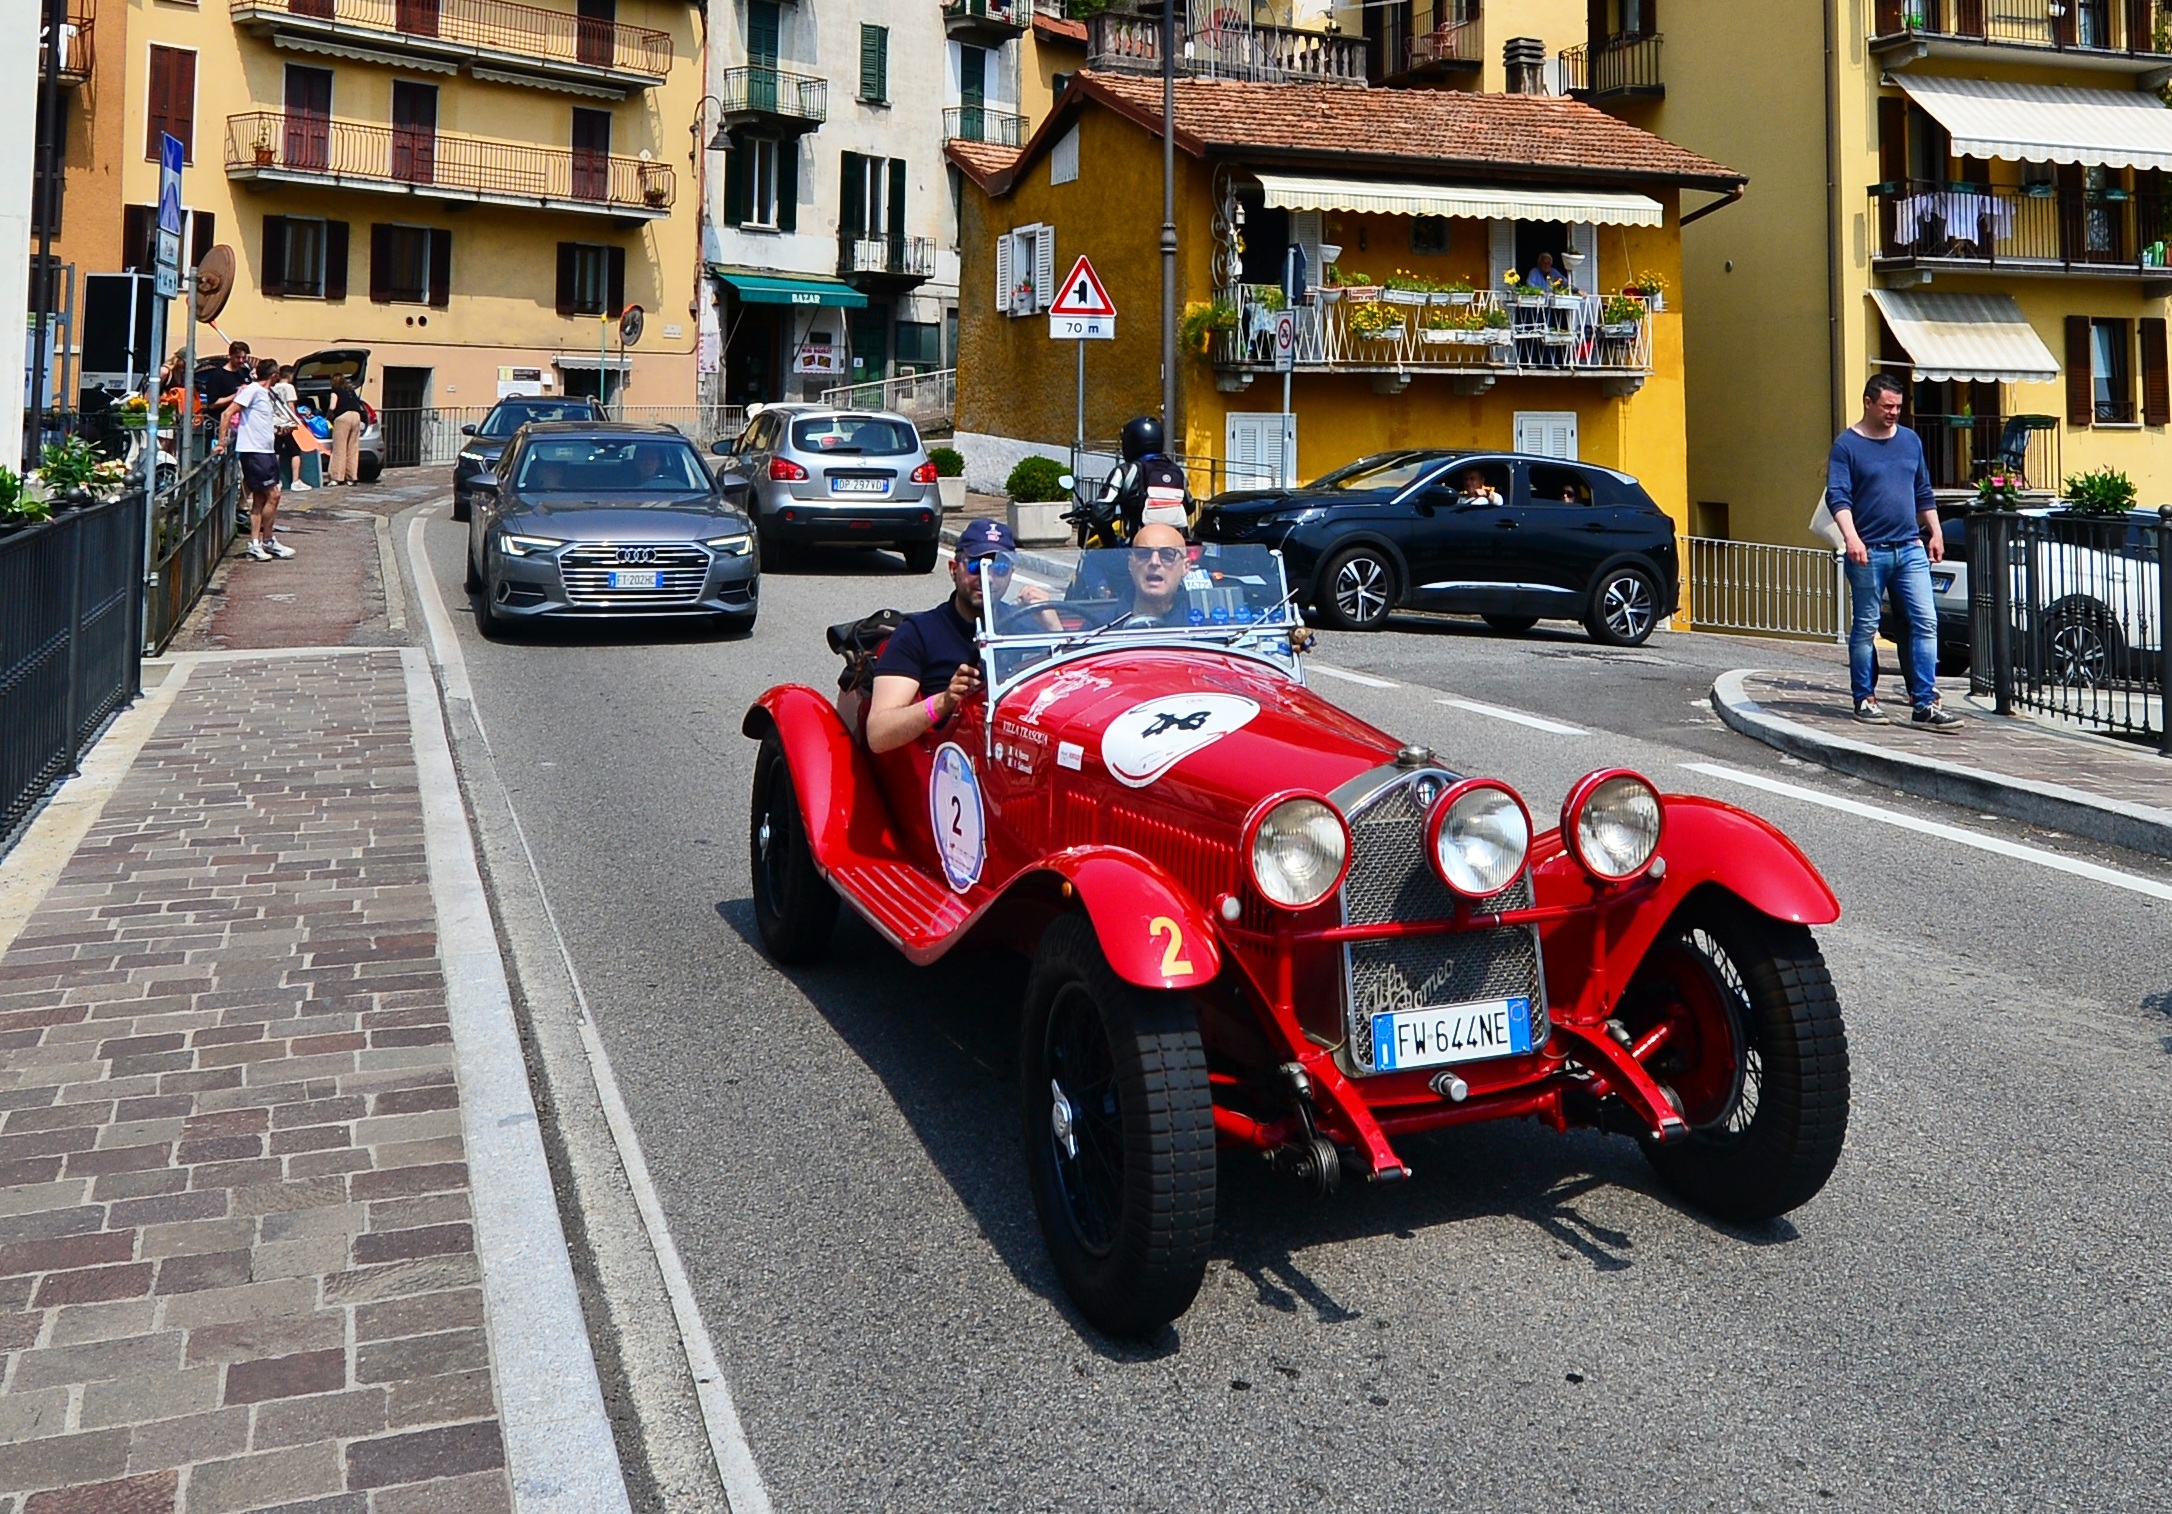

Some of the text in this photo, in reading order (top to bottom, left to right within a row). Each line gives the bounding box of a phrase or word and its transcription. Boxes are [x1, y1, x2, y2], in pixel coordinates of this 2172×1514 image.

[792, 293, 820, 304] BAZAR
[1066, 322, 1099, 333] 70 m
[839, 480, 850, 489] DP
[617, 574, 627, 585] FT
[951, 795, 963, 838] 2
[1149, 916, 1195, 977] 2
[1362, 963, 1408, 1021] Alfa
[1398, 1021, 1427, 1057] FW
[1435, 1011, 1508, 1052] 644NE
